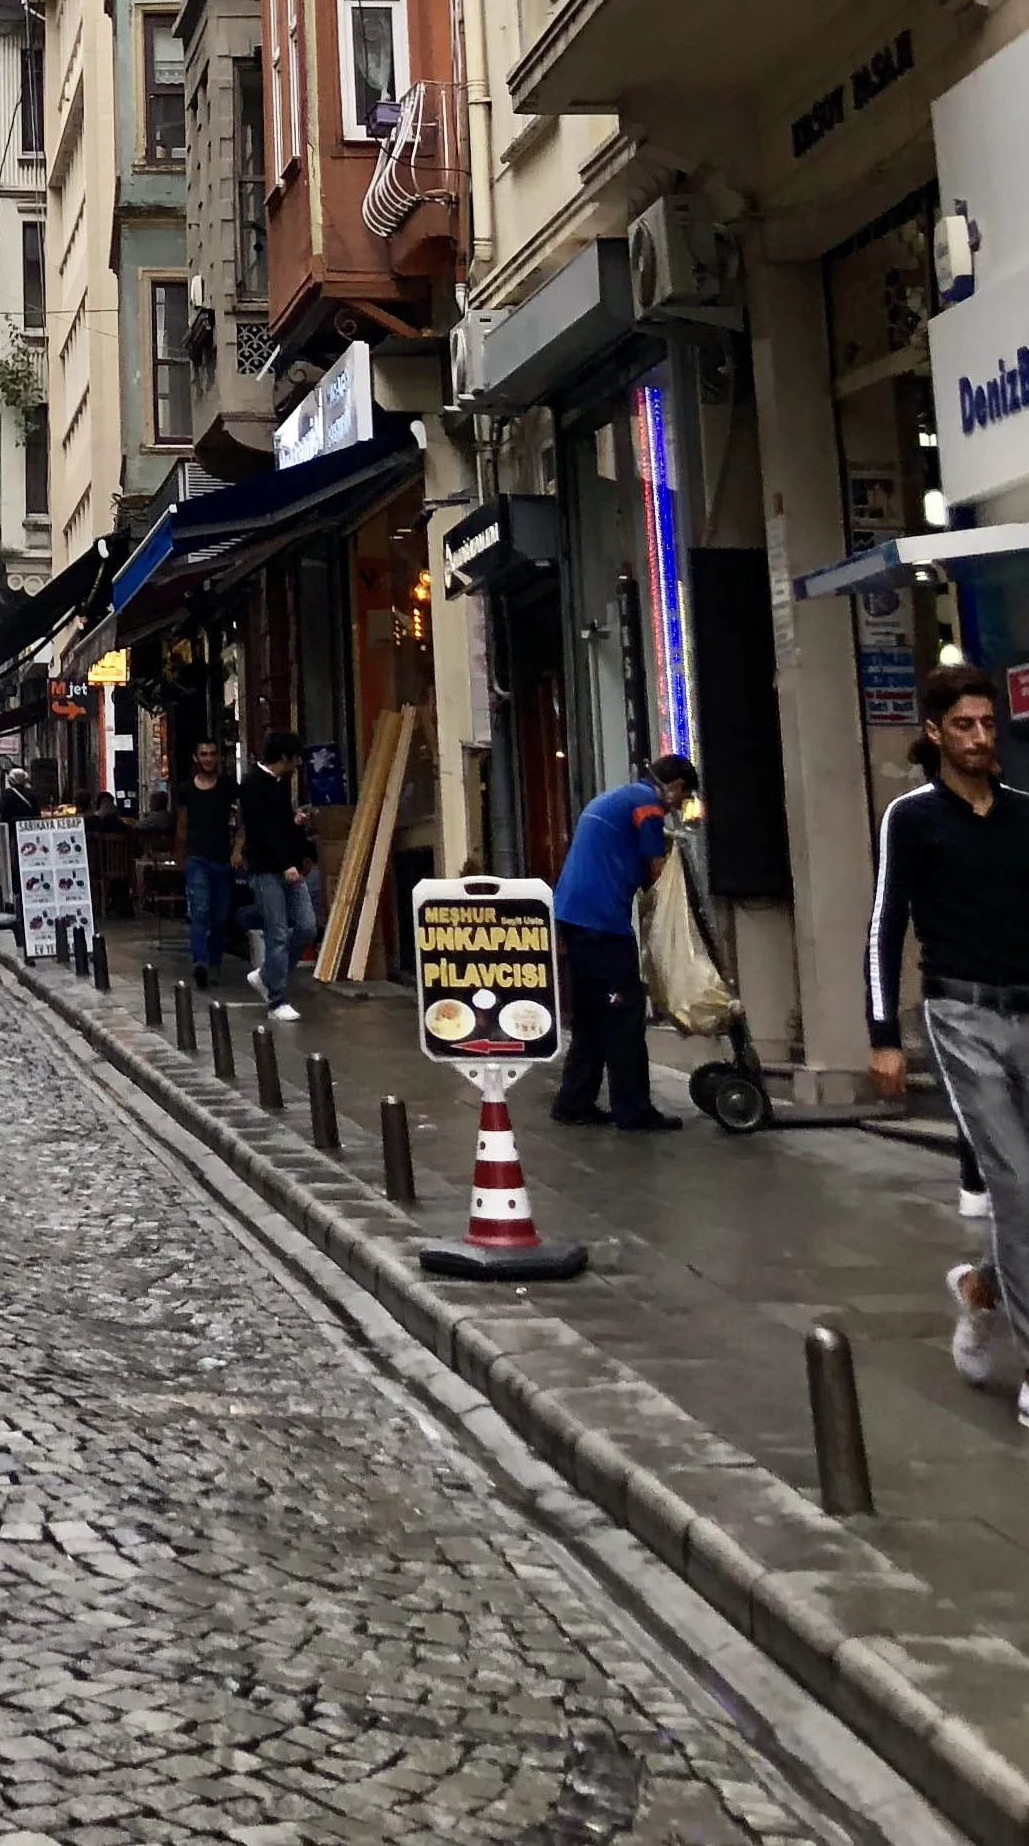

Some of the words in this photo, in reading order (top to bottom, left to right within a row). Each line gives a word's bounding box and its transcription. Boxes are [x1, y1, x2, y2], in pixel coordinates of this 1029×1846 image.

[66, 681, 88, 698] jet
[425, 907, 497, 926] MEŞHUR
[419, 927, 549, 951] UNKAPANI
[424, 957, 547, 988] PİLAVCISI
